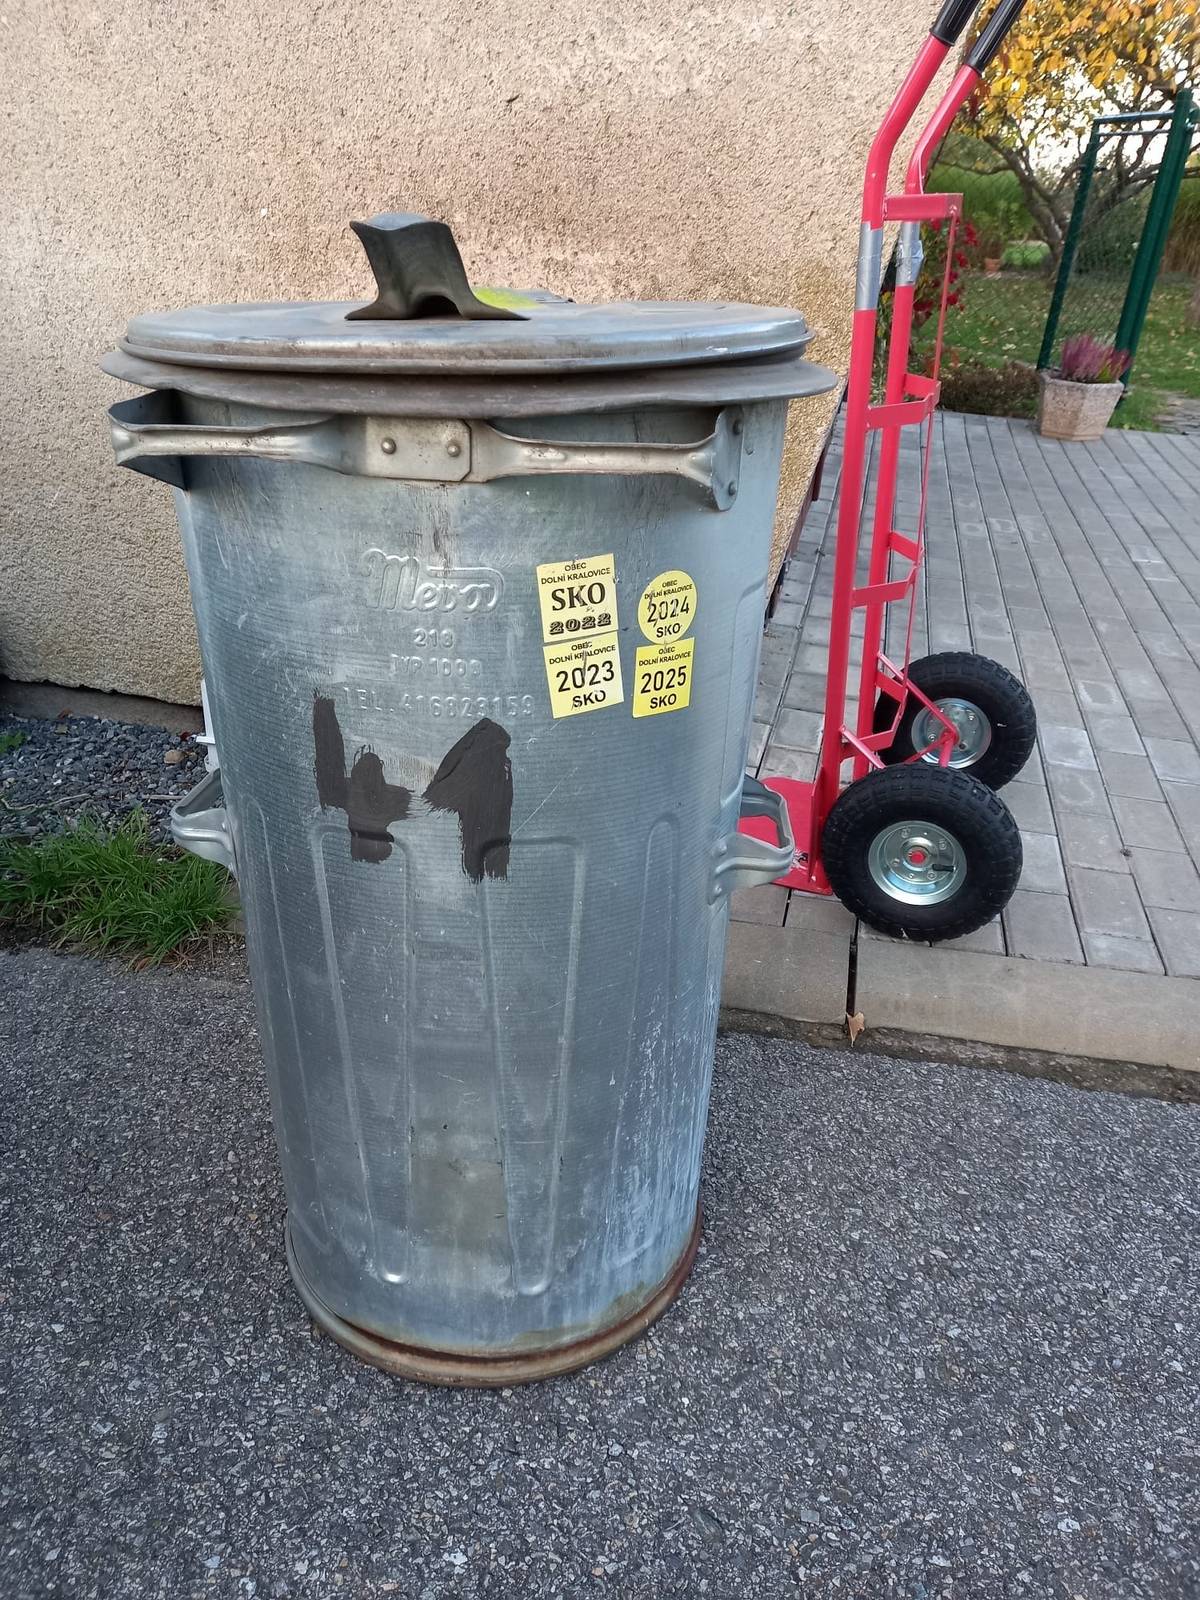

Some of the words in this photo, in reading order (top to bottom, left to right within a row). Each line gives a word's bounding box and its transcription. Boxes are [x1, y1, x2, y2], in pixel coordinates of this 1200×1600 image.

[564, 562, 586, 572] OBEC
[541, 573, 566, 584] DOLNÍ
[567, 568, 611, 581] KRALOVICE
[662, 580, 678, 588] OBEC
[551, 582, 606, 611] SKO
[663, 584, 693, 596] KRALOVICE
[647, 596, 690, 623] 2024
[549, 612, 612, 635] 2022
[656, 623, 681, 638] SKO
[571, 641, 592, 651] OBEC
[549, 653, 573, 665] DOLNÍ
[574, 645, 616, 660] KRALOVICE
[639, 657, 659, 666] DOLNÍ
[660, 651, 692, 663] KRALOVICE
[556, 660, 615, 692] 2023
[641, 665, 687, 694] 2025
[572, 690, 606, 708] SKO
[650, 693, 677, 709] SKO
